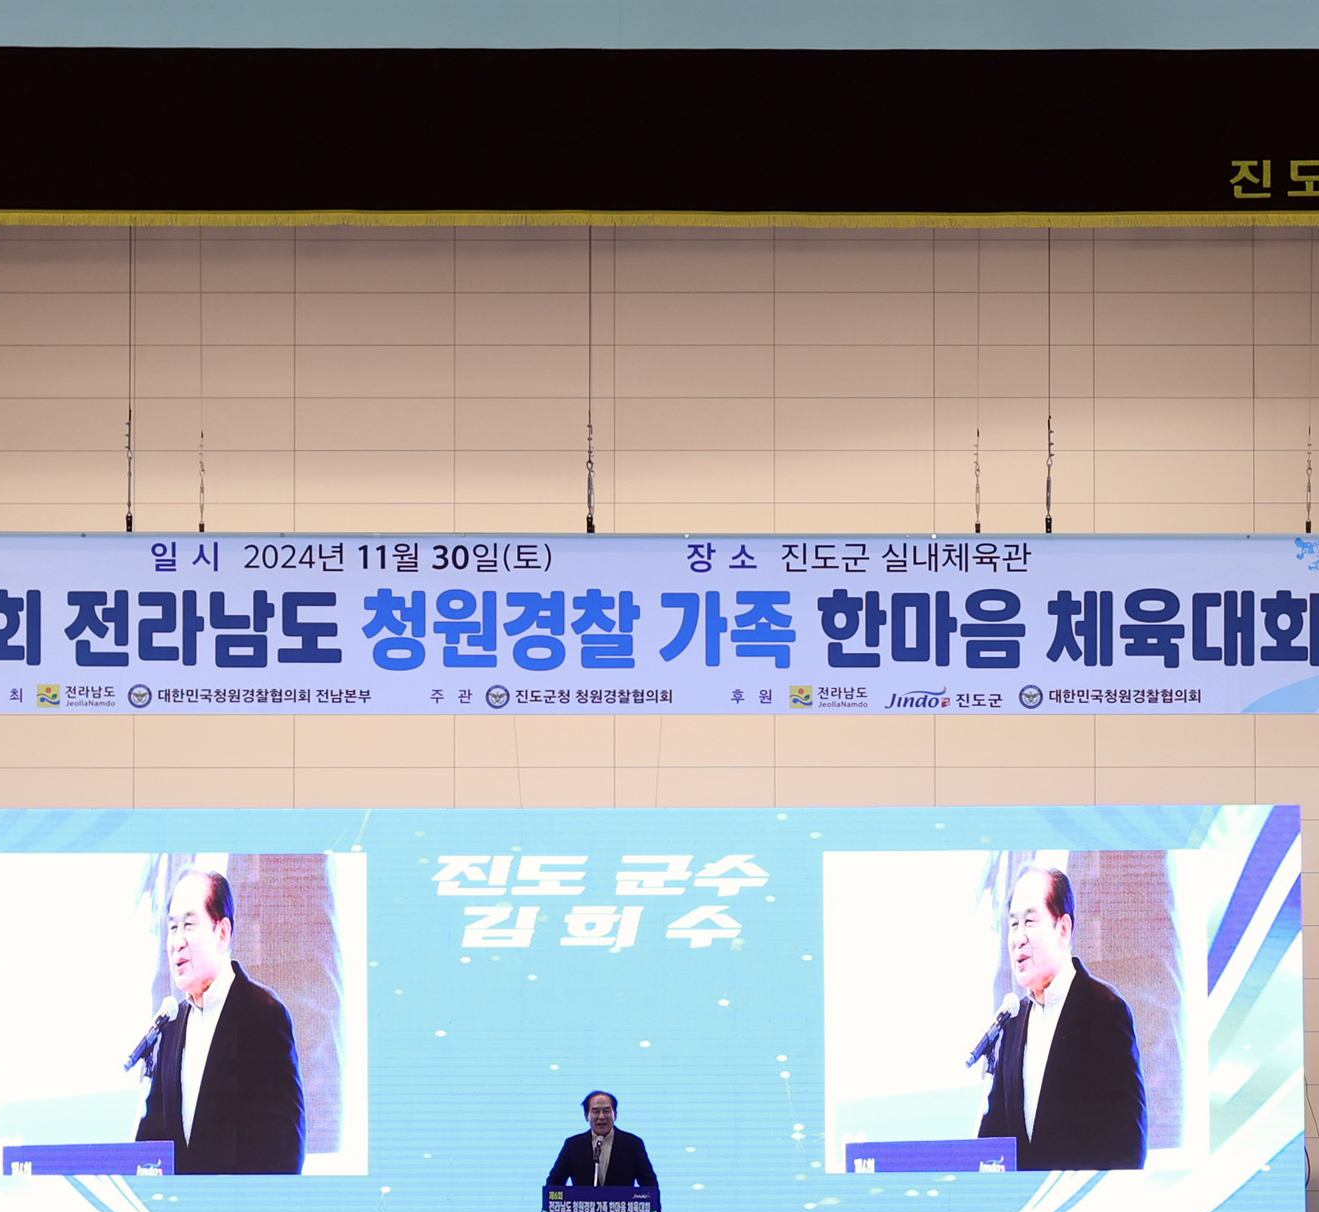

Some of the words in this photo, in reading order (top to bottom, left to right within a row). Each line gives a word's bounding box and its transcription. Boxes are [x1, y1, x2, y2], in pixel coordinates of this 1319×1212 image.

[243, 542, 347, 573] 2024년
[358, 543, 420, 573] 11월
[432, 541, 553, 573] 30일(토)
[780, 542, 870, 573] 진도군
[880, 541, 1032, 573] 실내체육관
[64, 588, 342, 669] 전라남도
[362, 587, 641, 671] 청원경찰
[658, 589, 797, 670] 가족
[816, 587, 1026, 670] 한마음
[65, 685, 116, 699] 전라남도
[157, 687, 312, 704] 대한민국청원경찰협의회
[315, 687, 372, 704] 전남본부
[515, 688, 571, 704] 진도군청
[575, 688, 673, 704] 청원경찰협의회
[817, 686, 869, 700] 전라남도
[1048, 688, 1202, 705] 대한민국청원경찰협의회
[65, 699, 116, 708] JeollaNamdo
[817, 700, 869, 709] JeollaNamdo
[884, 693, 939, 709] Jindo
[955, 692, 1004, 709] 진도군
[430, 854, 589, 896] 진도
[614, 854, 771, 897] 군수
[548, 1201, 572, 1212] 전라남도
[572, 1201, 596, 1212] 청원경찰
[596, 1201, 608, 1212] 가족
[609, 1201, 626, 1212] 한마음
[627, 1201, 651, 1212] 체육대회
